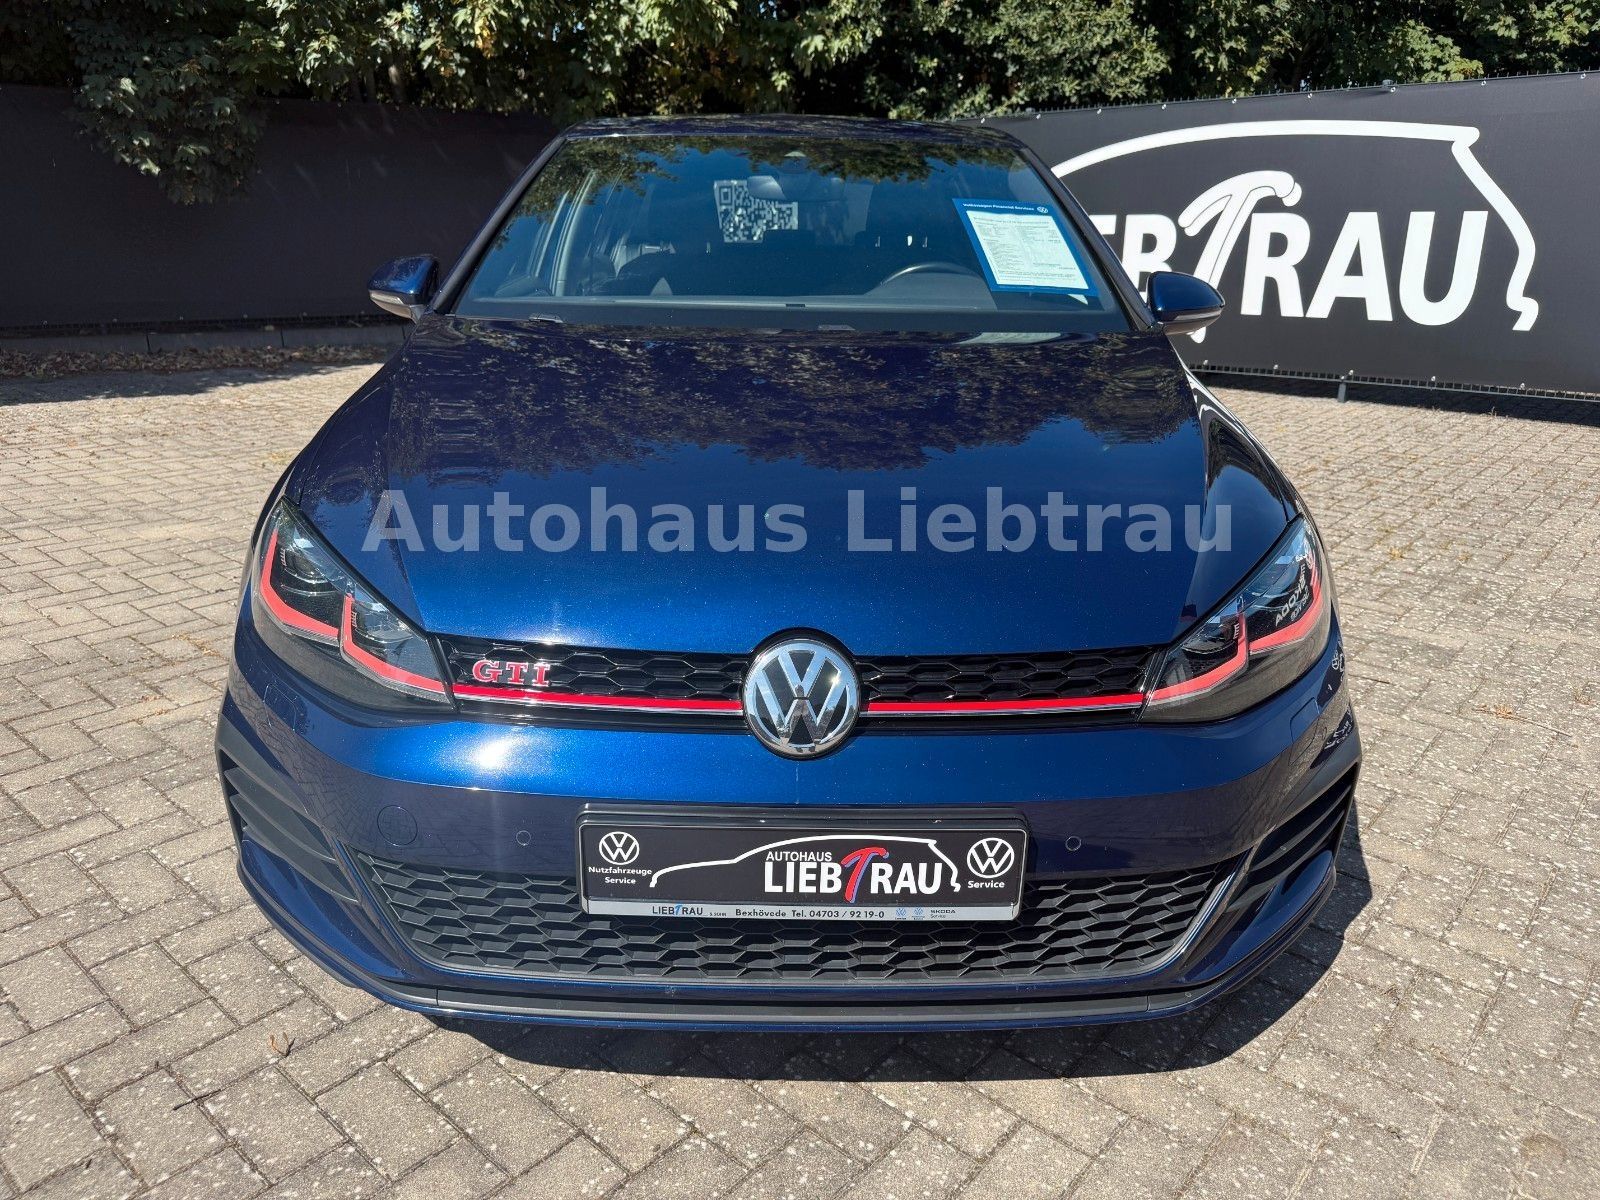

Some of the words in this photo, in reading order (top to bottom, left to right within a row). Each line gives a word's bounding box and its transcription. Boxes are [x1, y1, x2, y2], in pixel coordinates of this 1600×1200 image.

[472, 659, 551, 687] GTI
[766, 851, 833, 862] AUTOHAUS
[588, 866, 652, 876] Nutzfahrzeuge
[764, 846, 943, 903] LIEBTRAU
[604, 877, 636, 885] Service
[967, 880, 1005, 889] Service
[652, 904, 703, 916] LIEBTRAU
[735, 908, 787, 918] Bexhövede
[791, 909, 806, 918] Tel.
[809, 909, 839, 918] 04703
[841, 910, 847, 918] /
